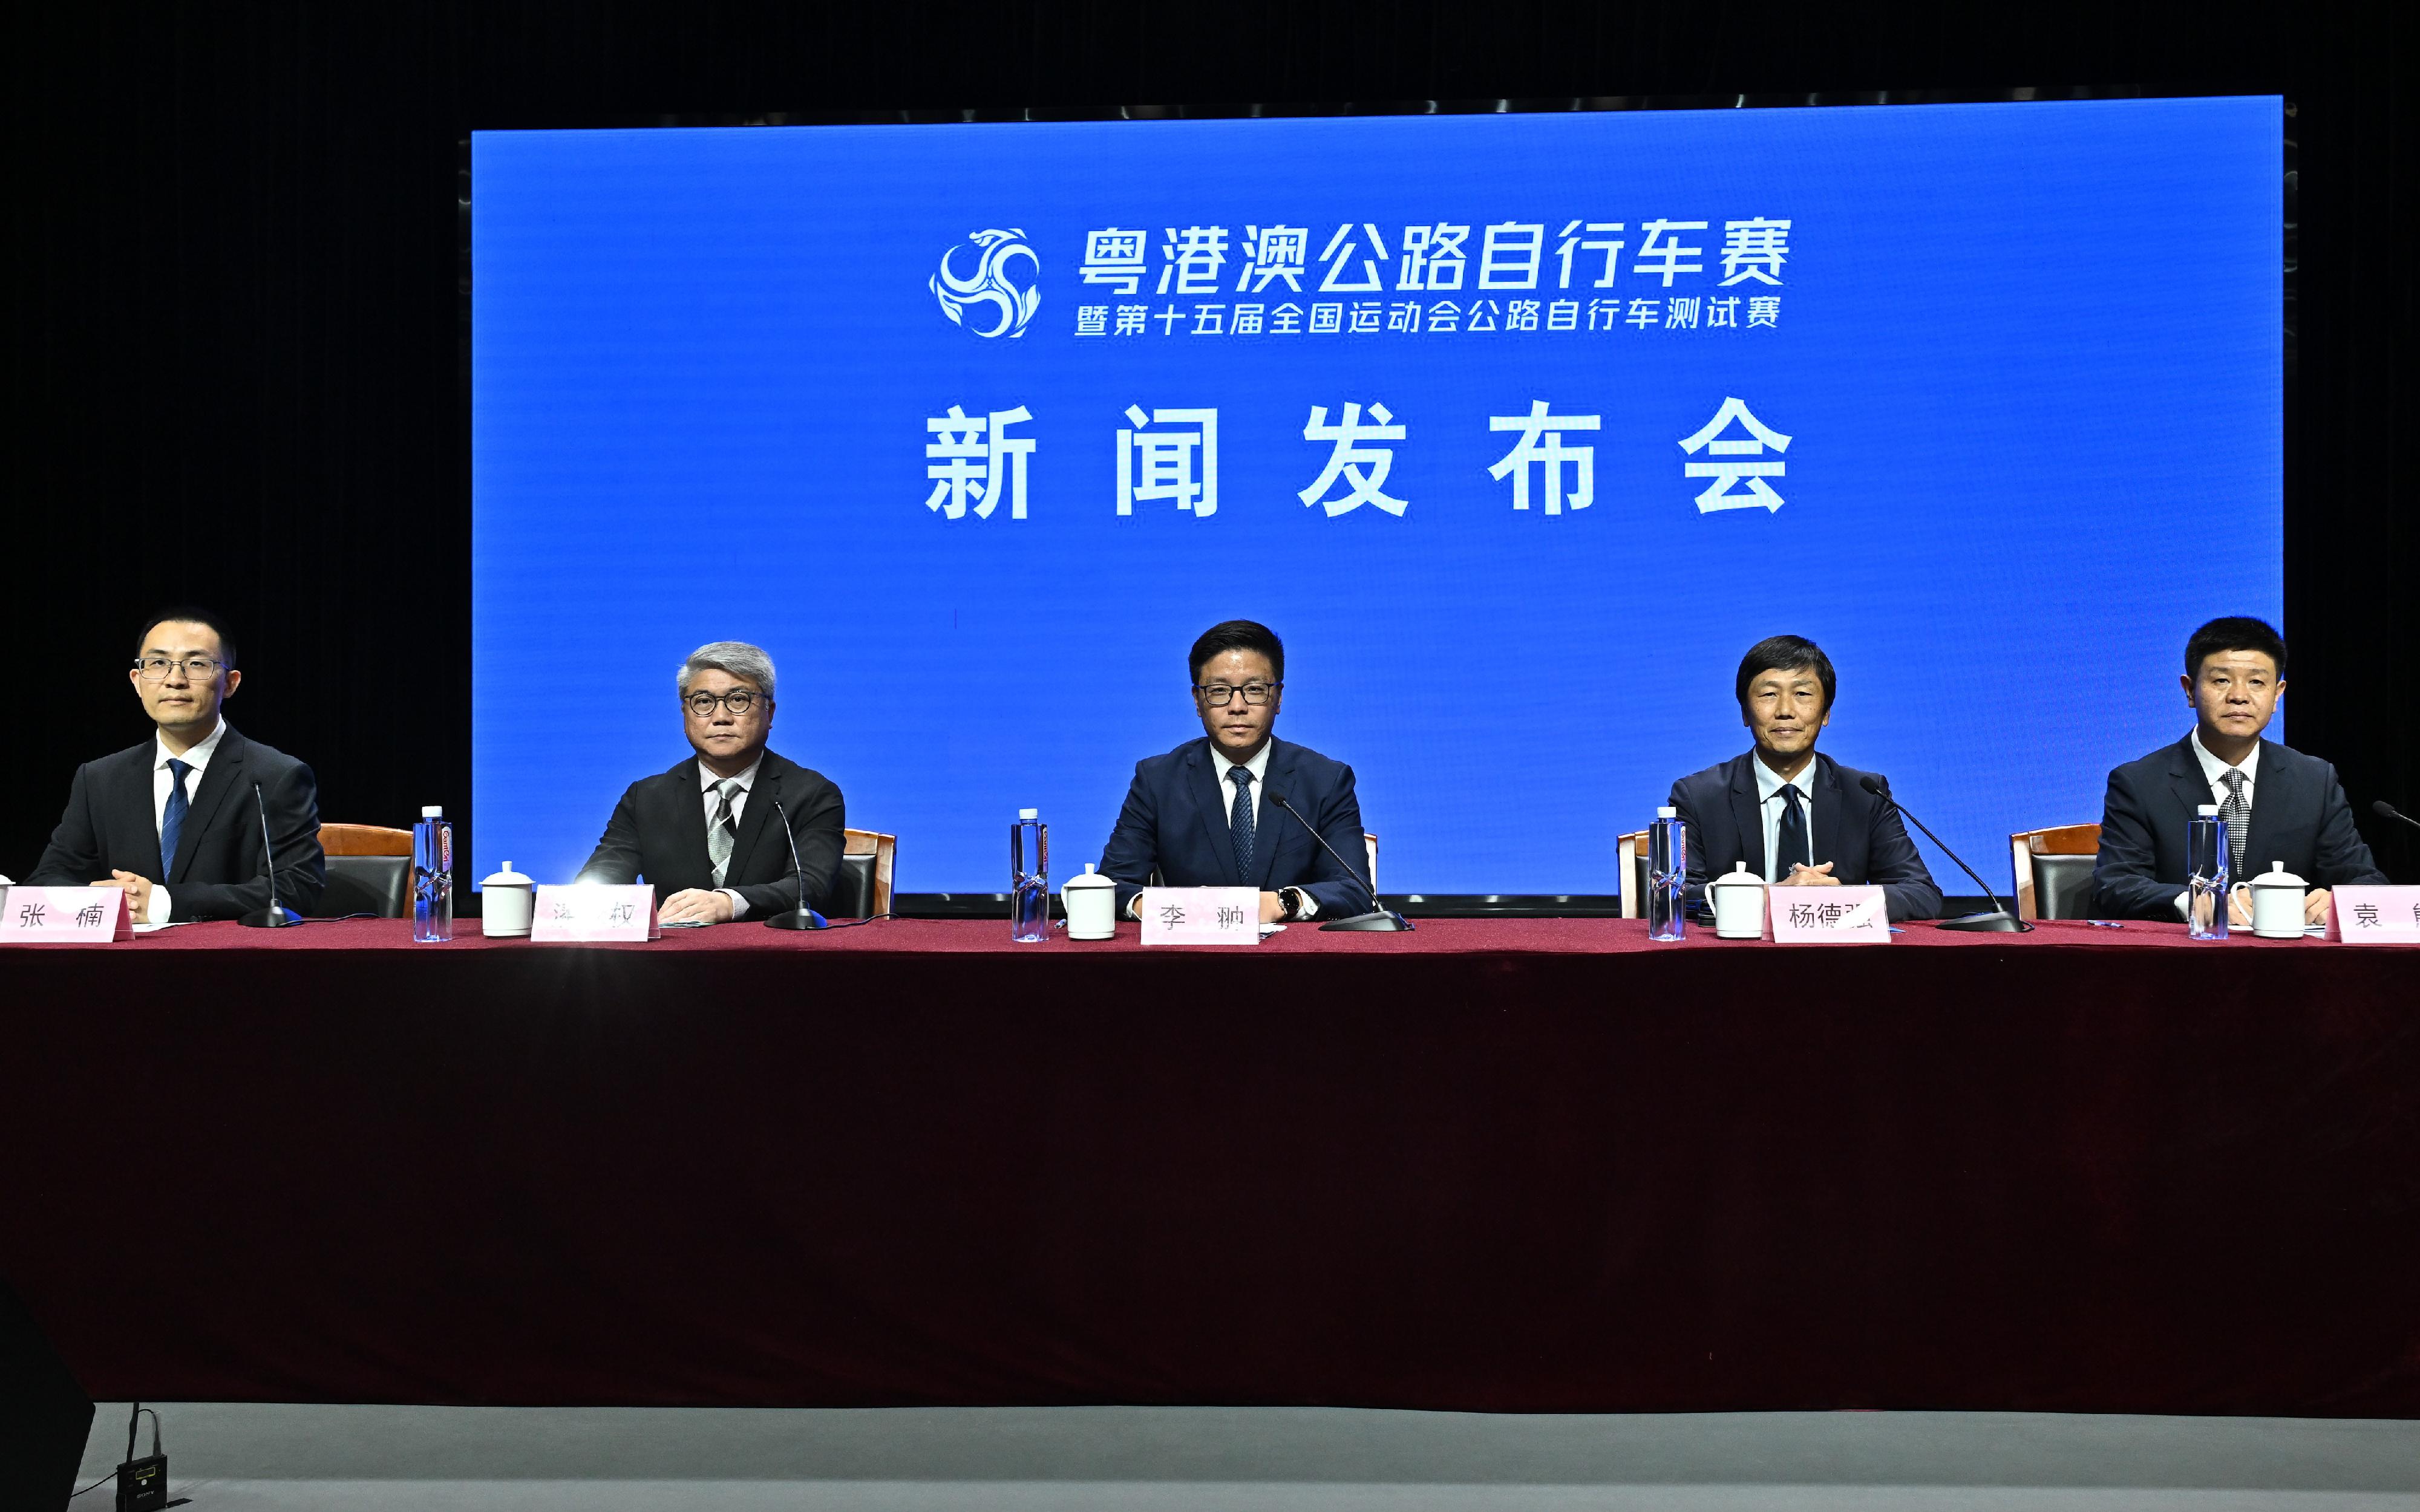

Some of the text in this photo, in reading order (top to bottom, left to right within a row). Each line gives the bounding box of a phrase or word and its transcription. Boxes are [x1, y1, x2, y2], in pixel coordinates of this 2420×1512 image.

[1079, 217, 1792, 295] 粤港澳公路自行车赛
[1074, 296, 1781, 336] 暨第十五届全国运动会公路自行车测试赛
[925, 396, 1792, 520] 新闻发布会
[20, 903, 104, 928] 张楠
[136, 1490, 155, 1499] SONY
